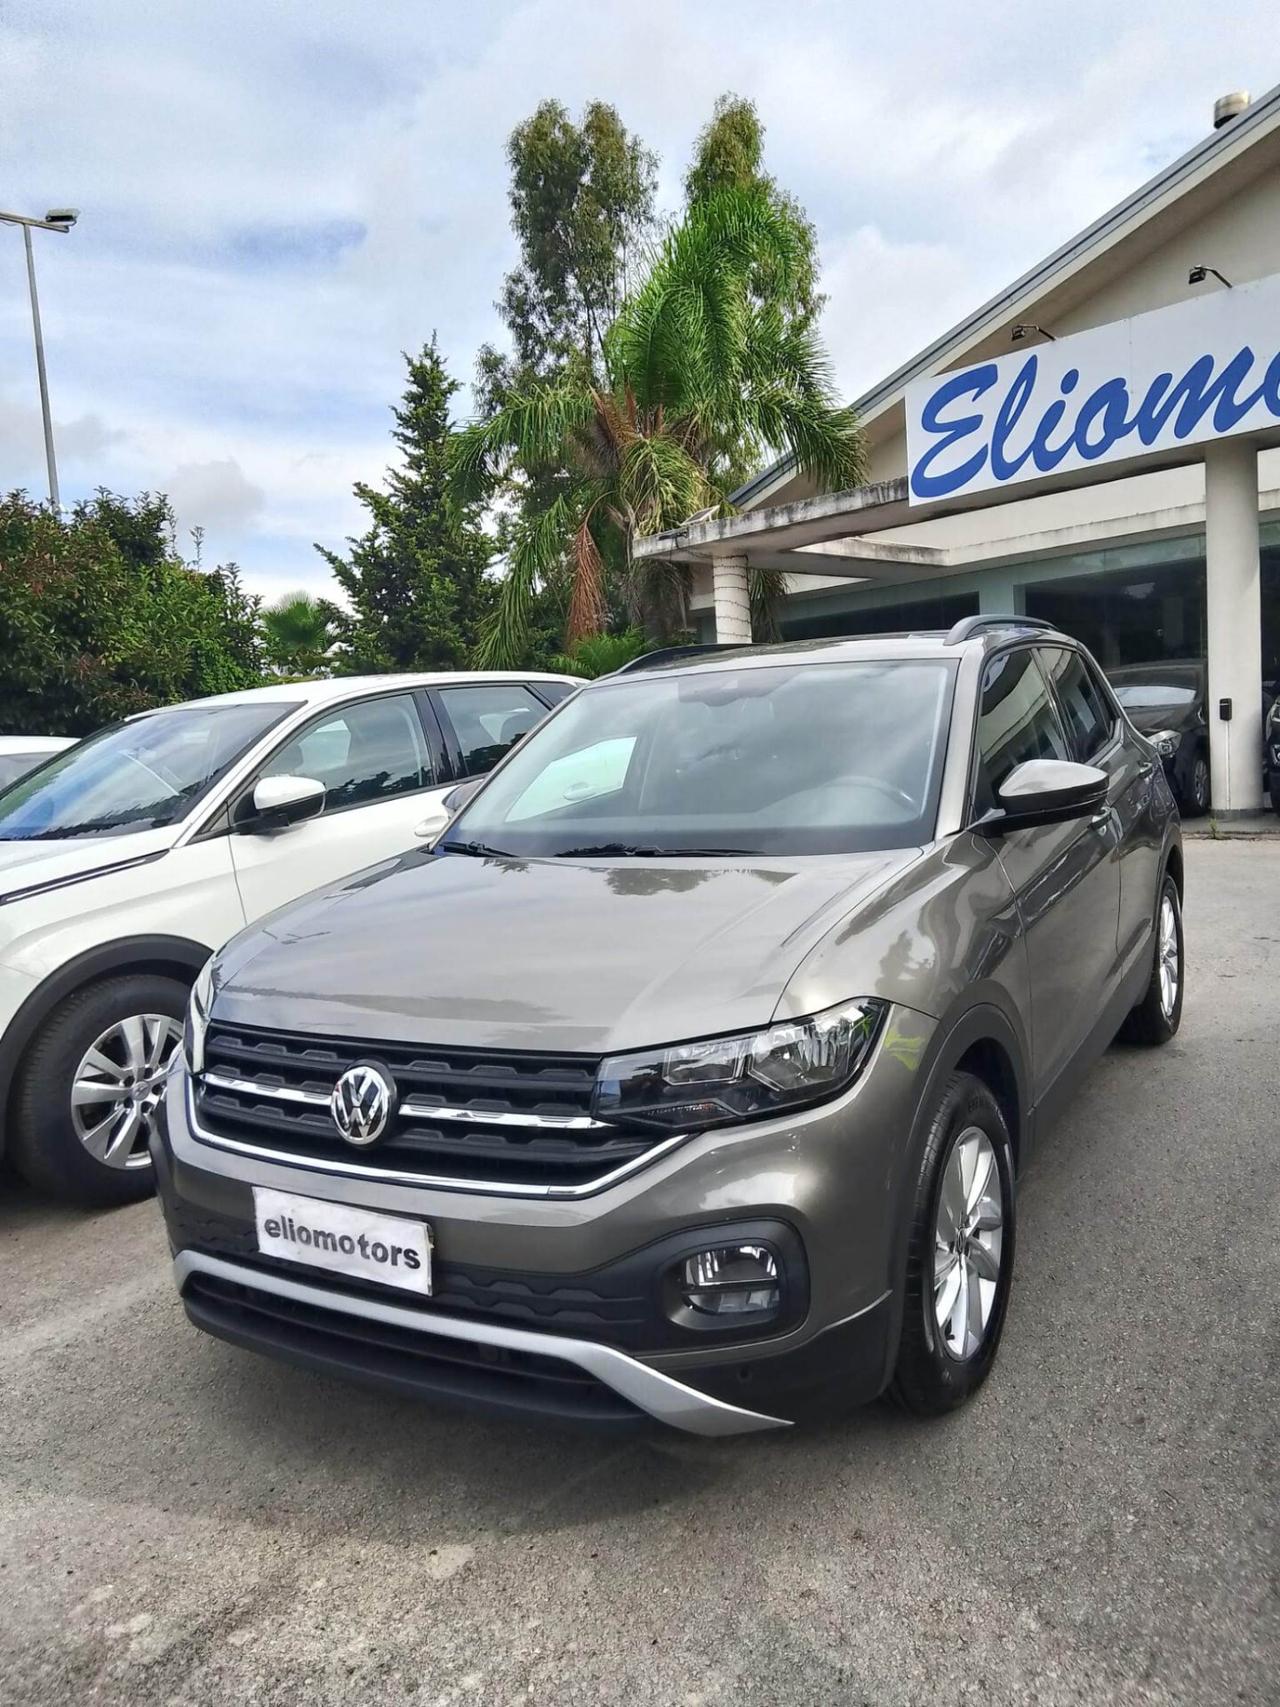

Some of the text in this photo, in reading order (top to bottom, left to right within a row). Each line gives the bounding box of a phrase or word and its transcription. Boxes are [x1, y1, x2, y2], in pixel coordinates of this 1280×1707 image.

[910, 346, 1280, 498] Eliom
[332, 1064, 390, 1145] VW
[264, 1215, 421, 1270] eliomotors
